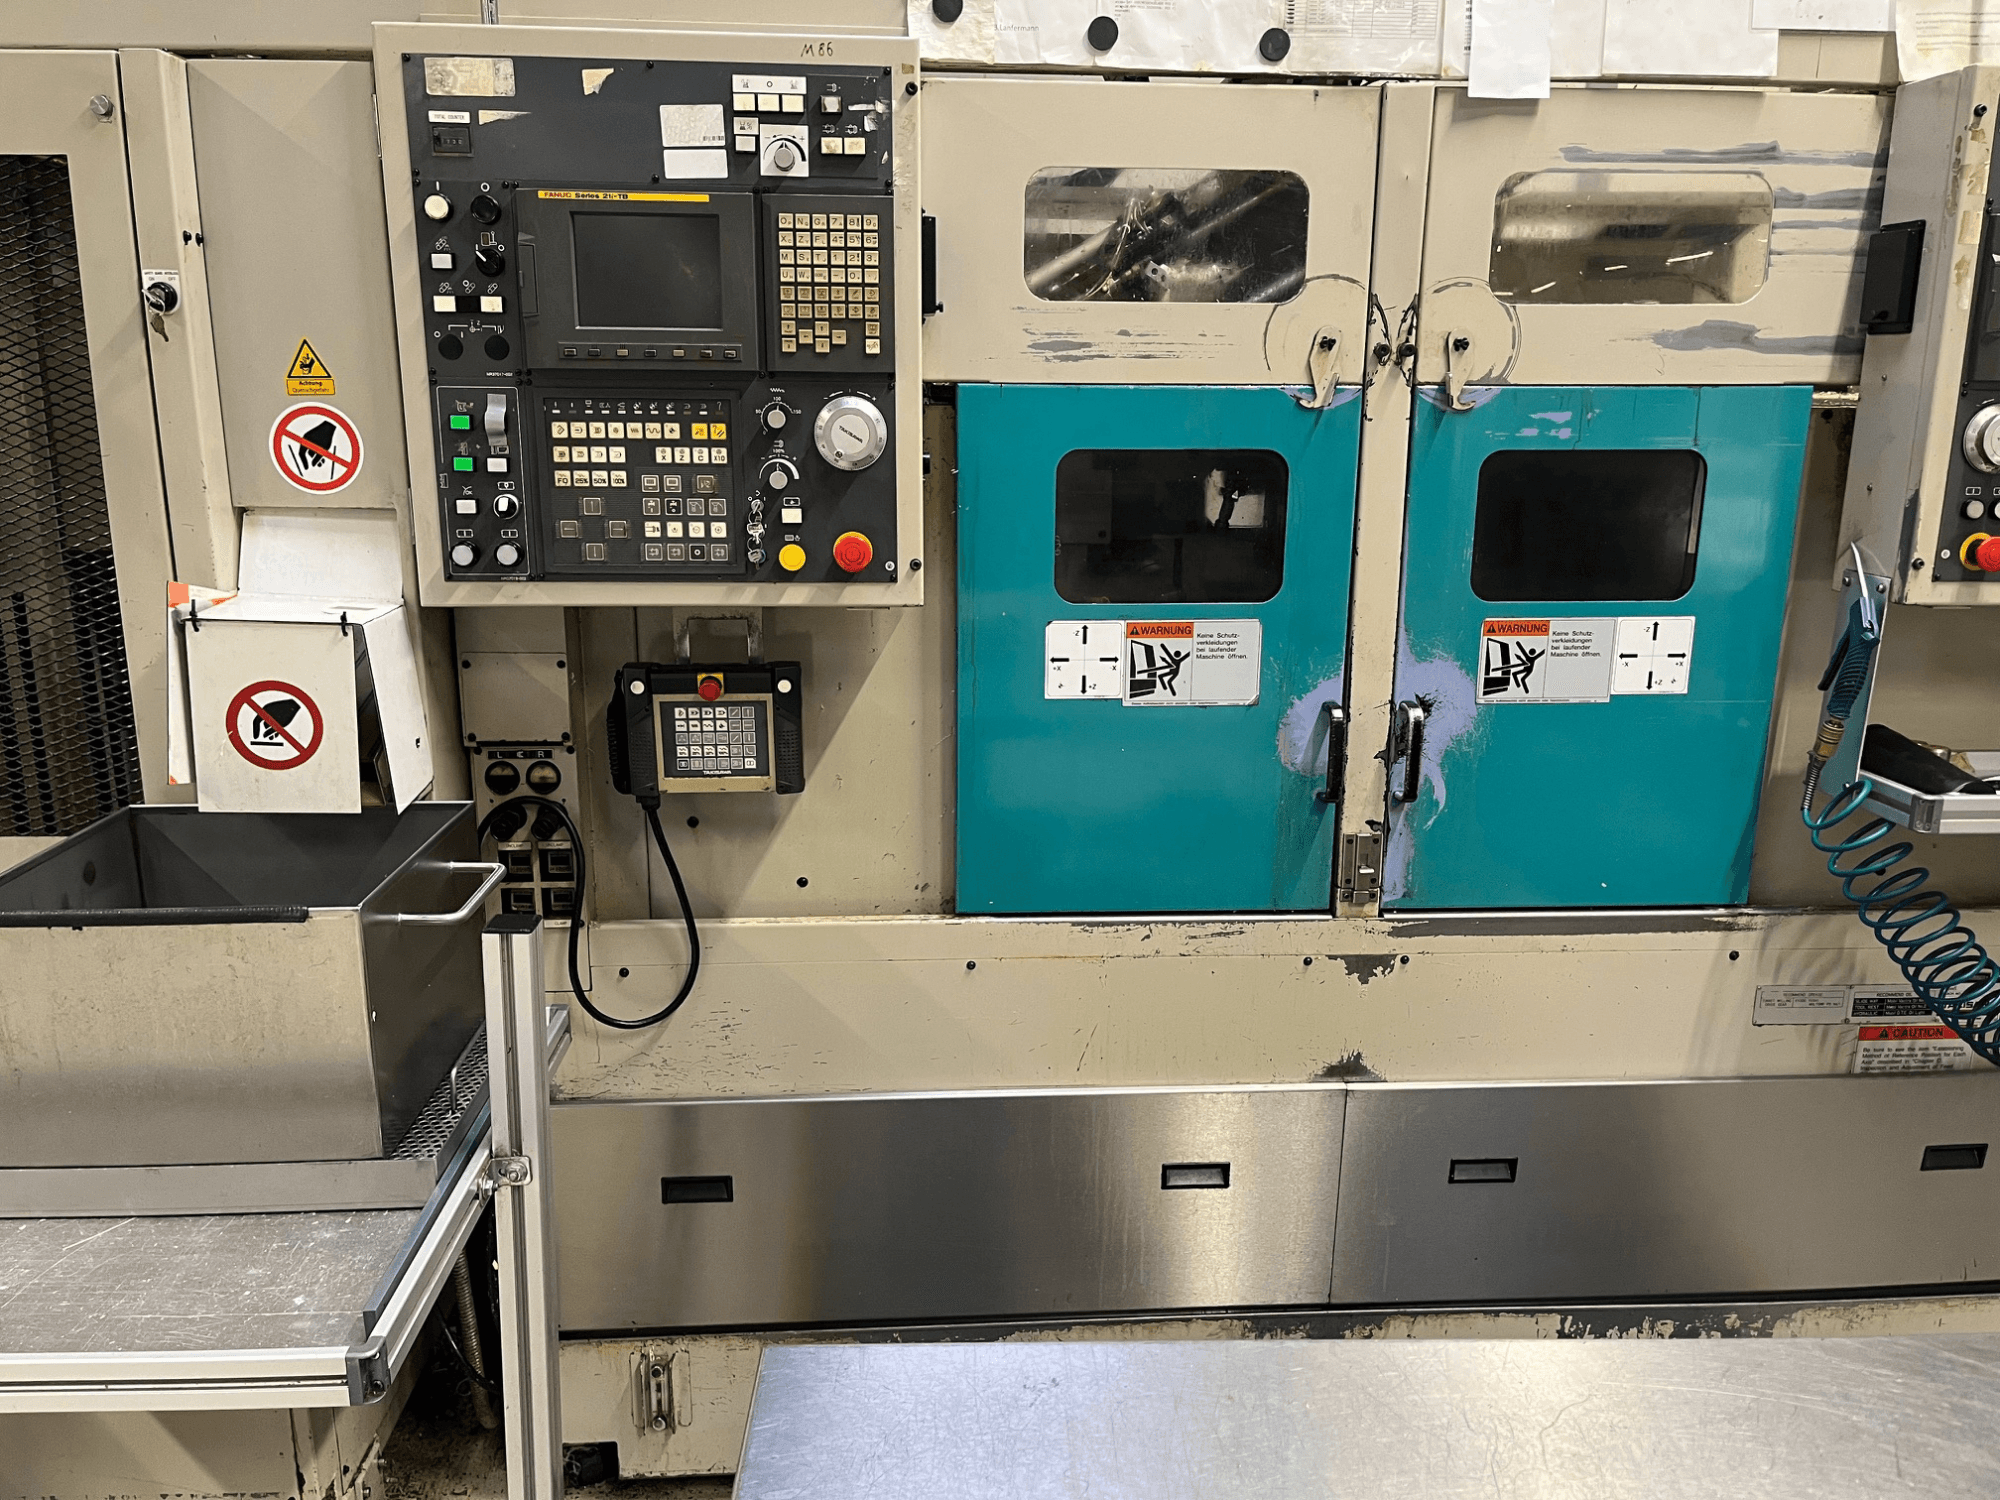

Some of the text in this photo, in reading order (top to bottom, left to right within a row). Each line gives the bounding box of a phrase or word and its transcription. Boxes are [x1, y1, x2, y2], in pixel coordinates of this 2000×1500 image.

[1141, 626, 1192, 635] WARNUNG
[1498, 624, 1548, 633] WARNUNG
[1893, 1029, 1943, 1038] CAUTION
